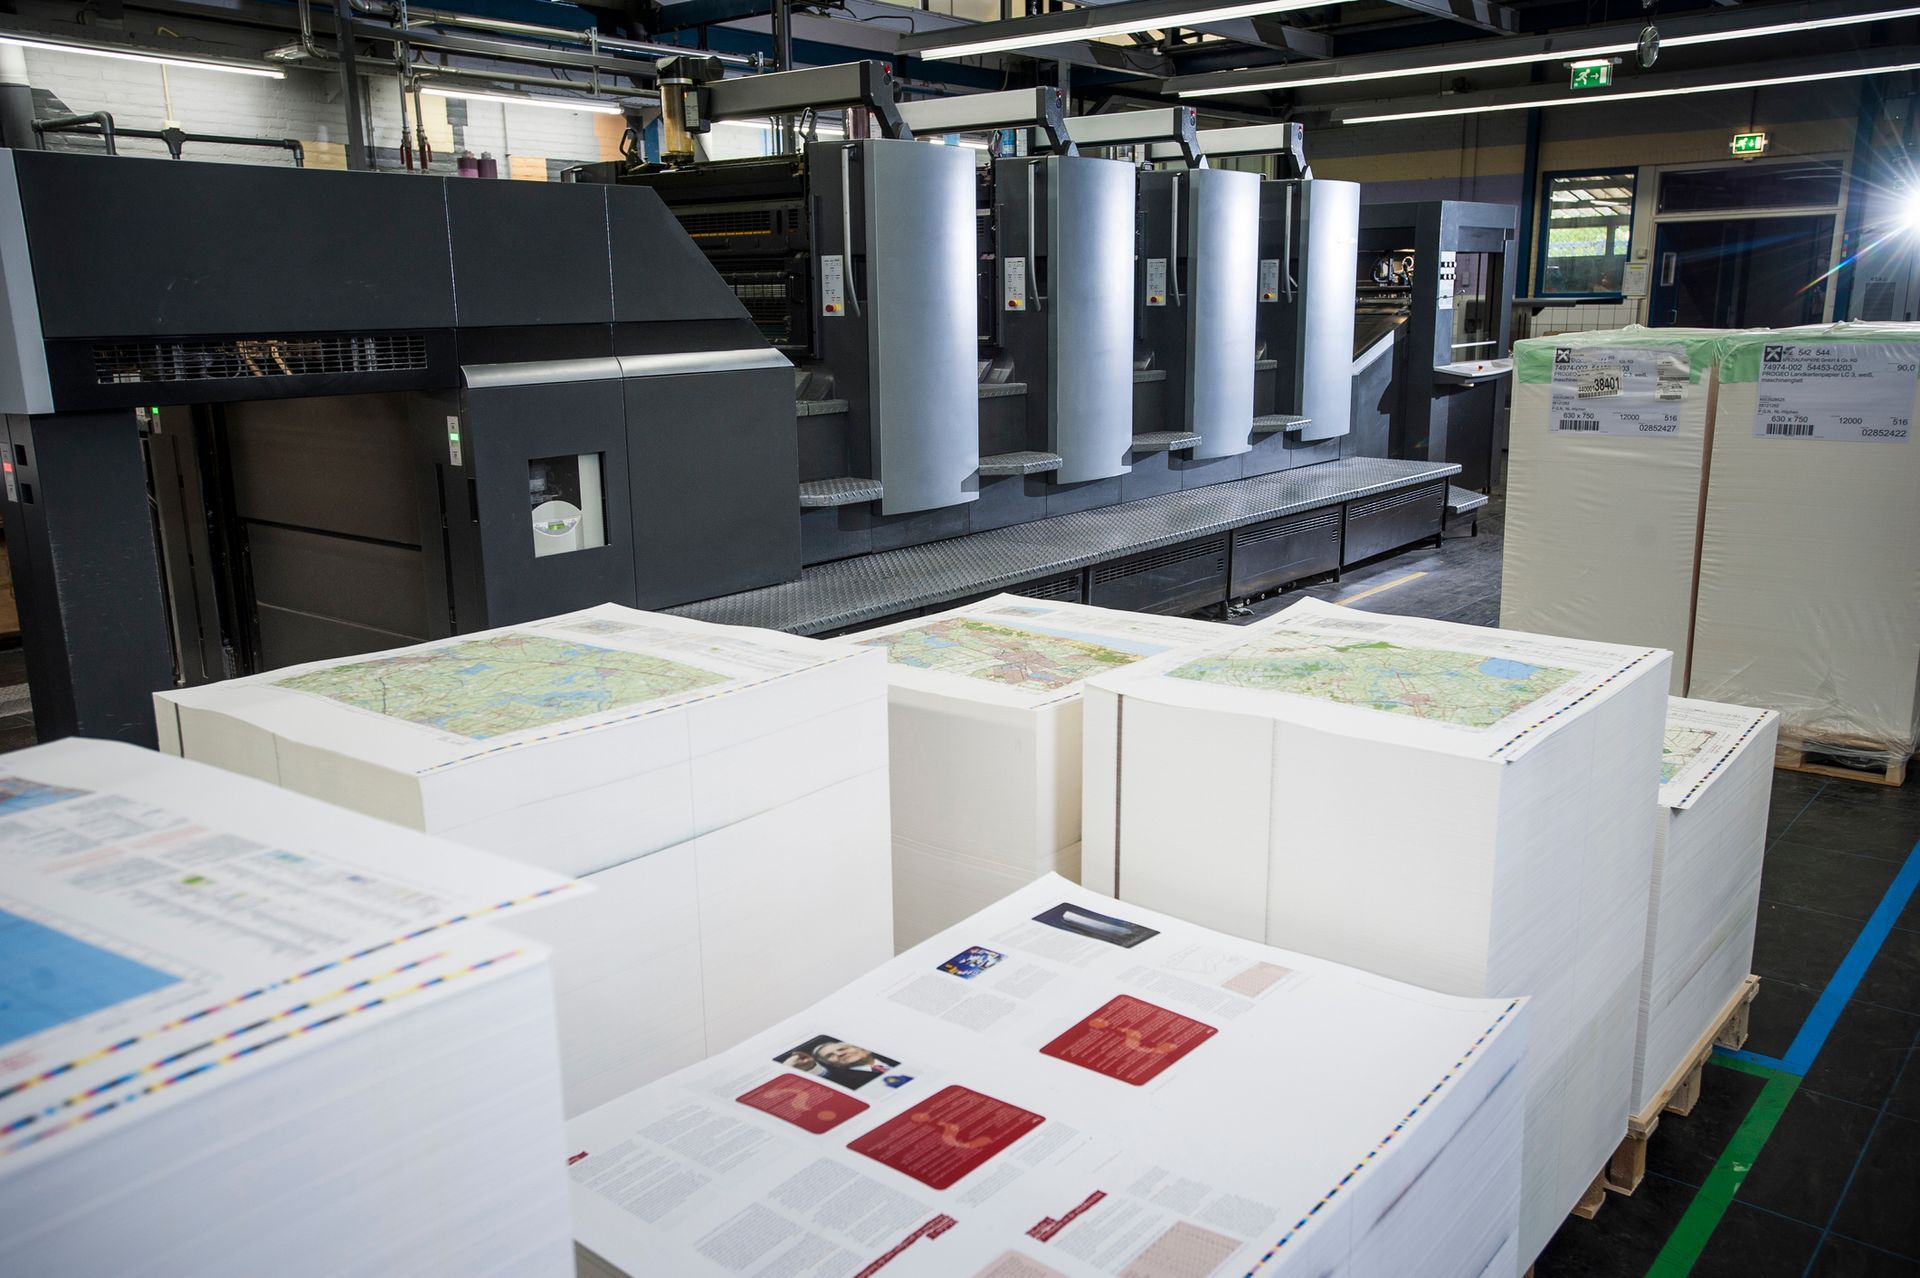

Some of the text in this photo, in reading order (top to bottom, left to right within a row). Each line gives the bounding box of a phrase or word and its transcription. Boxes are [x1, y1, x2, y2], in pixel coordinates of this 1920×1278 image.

[1807, 364, 1852, 372] 54453-0203
[1897, 364, 1916, 372] 90,0
[1639, 424, 1677, 432] 02852427
[1862, 429, 1907, 437] 02852422
